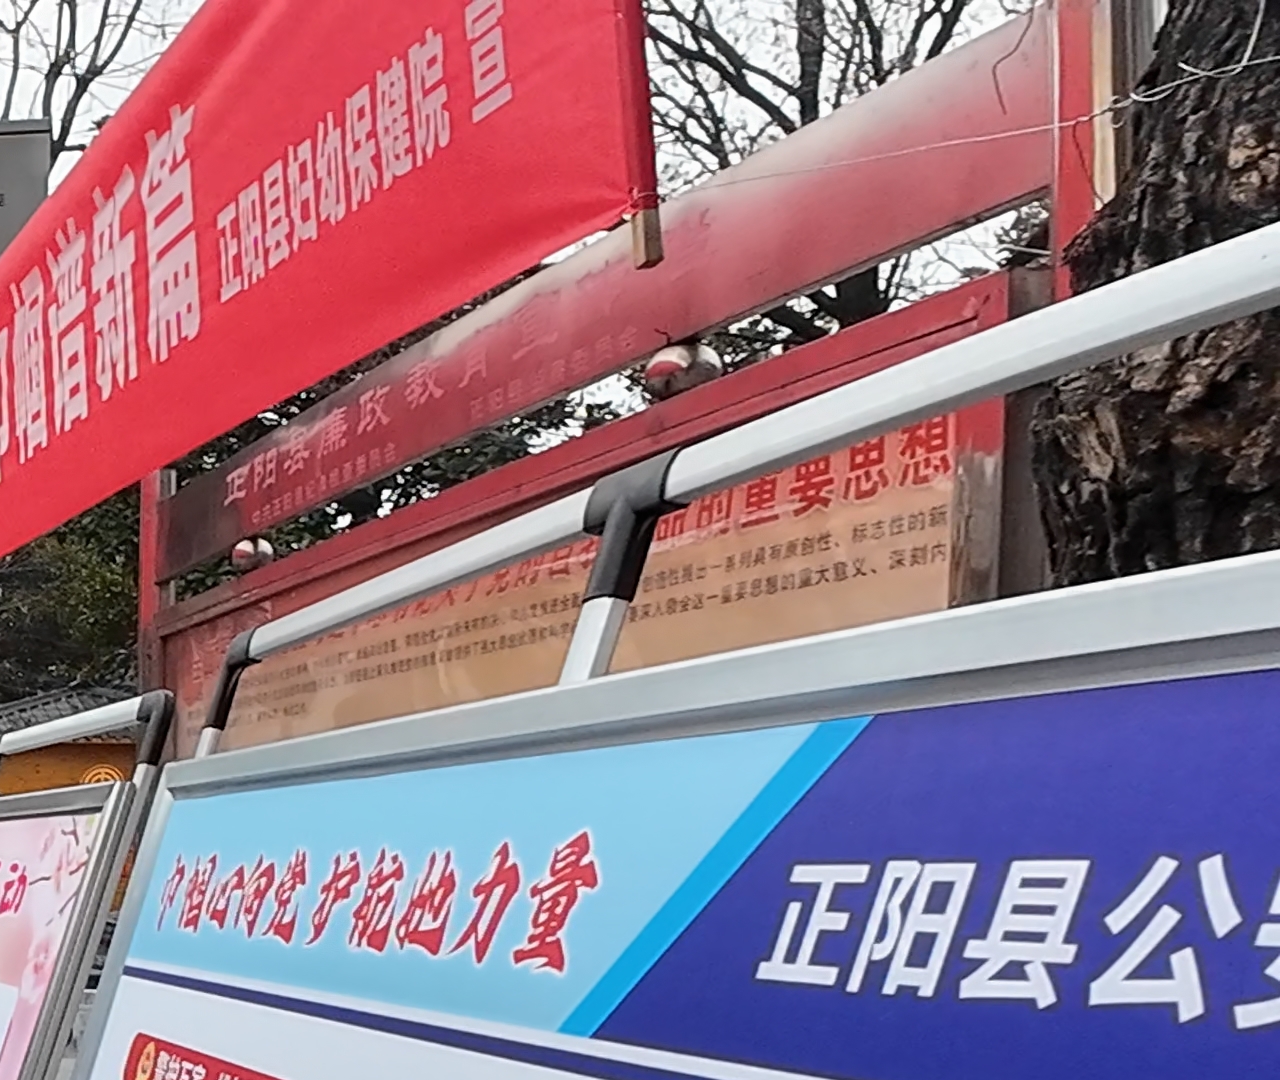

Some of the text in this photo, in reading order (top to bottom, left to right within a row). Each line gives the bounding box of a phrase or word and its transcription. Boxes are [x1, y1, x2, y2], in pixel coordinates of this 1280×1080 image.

[216, 27, 450, 303] 正阳县妇幼保健院
[465, 0, 512, 123] 宣
[156, 831, 599, 972] 巾帼心向党 护航她力量
